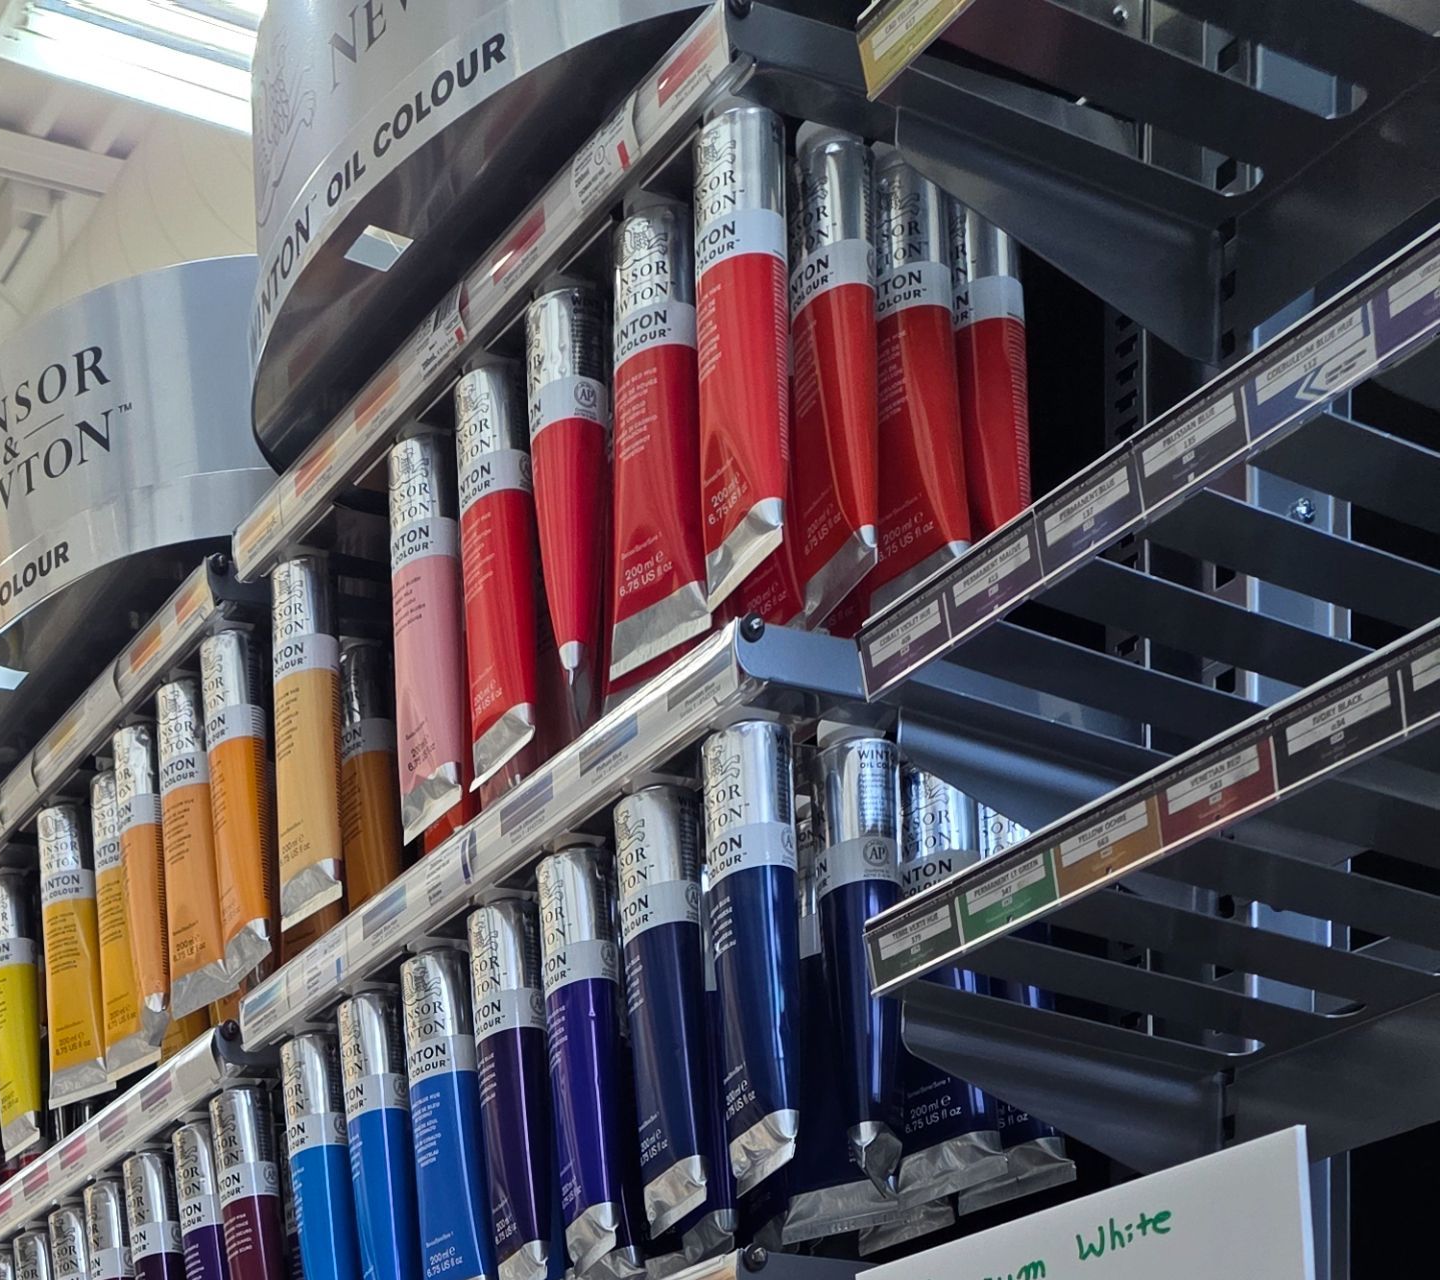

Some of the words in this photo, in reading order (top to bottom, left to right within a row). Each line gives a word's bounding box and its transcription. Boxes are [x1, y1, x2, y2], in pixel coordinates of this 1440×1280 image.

[248, 205, 311, 338] INTON
[326, 150, 366, 207] OIL
[373, 33, 506, 158] COLOUR
[616, 310, 668, 348] INTON
[2, 436, 20, 466] &
[624, 562, 644, 581] 200
[1075, 1210, 1172, 1261] White
